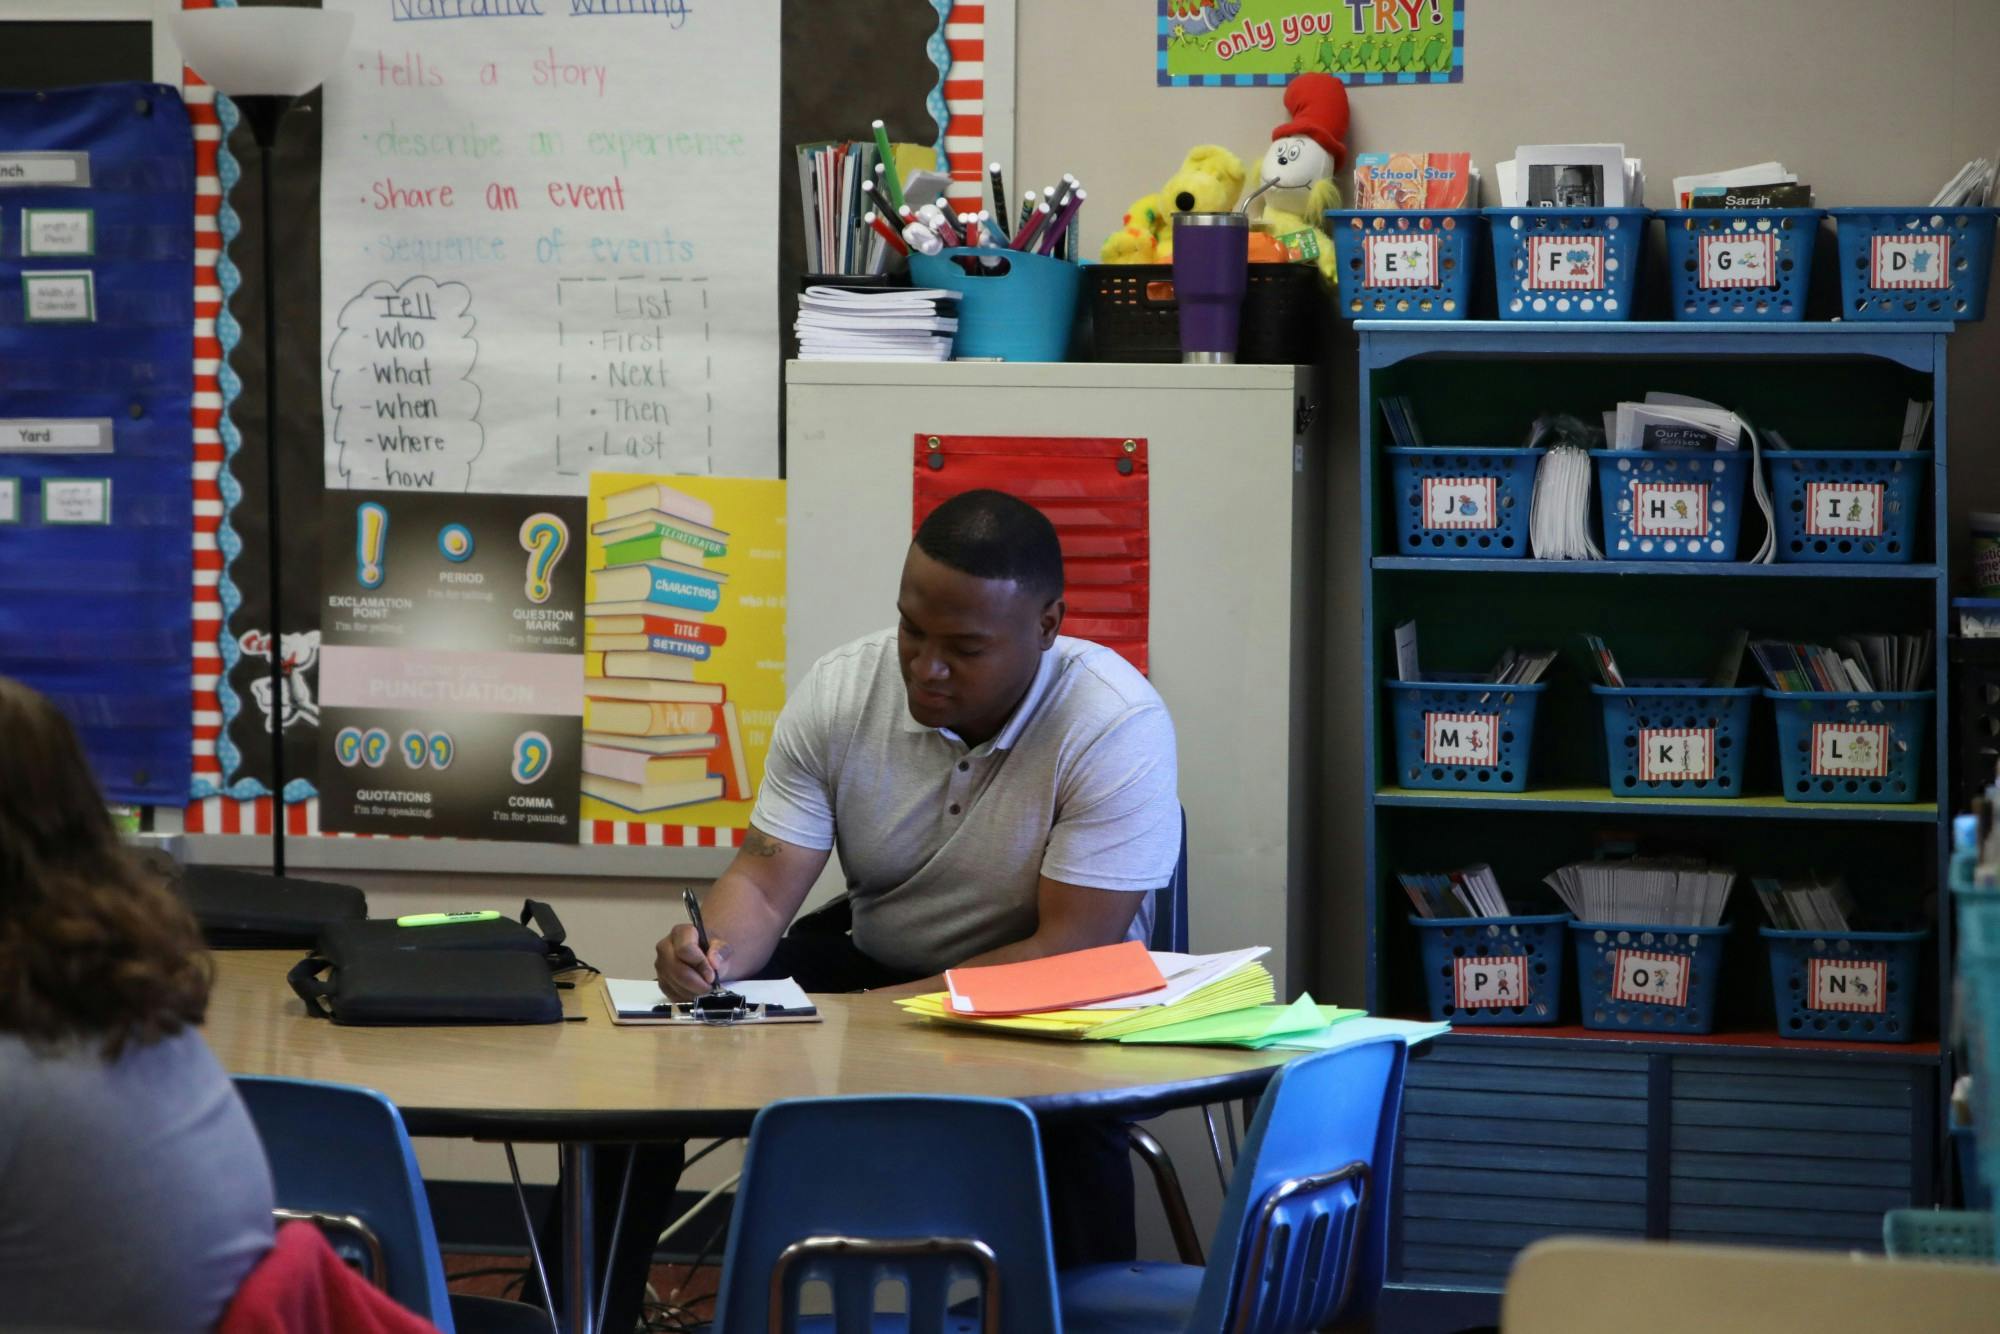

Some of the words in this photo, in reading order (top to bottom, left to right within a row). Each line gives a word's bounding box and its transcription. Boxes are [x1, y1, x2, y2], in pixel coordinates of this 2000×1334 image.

[1216, 18, 1274, 59] only
[1283, 13, 1332, 44] you
[1346, 0, 1443, 33] TRY!
[378, 51, 444, 87] tells
[479, 62, 499, 86] a
[532, 47, 607, 97] story
[375, 120, 503, 159] describe
[529, 130, 564, 157] an
[587, 129, 746, 168] experience
[1370, 167, 1419, 180] School
[1424, 168, 1456, 180] Star
[486, 181, 519, 211] an
[547, 175, 626, 211] event
[1725, 195, 1771, 206] Sarah
[536, 226, 563, 264] of
[590, 226, 695, 264] events
[1385, 253, 1398, 272] E
[1550, 252, 1562, 272] F
[1717, 250, 1732, 271] G
[1892, 251, 1907, 271] D
[613, 285, 673, 319] List
[602, 325, 664, 352] First
[372, 356, 432, 387] what
[609, 358, 671, 388] Next
[376, 391, 439, 420] when
[608, 397, 671, 426] Then
[18, 428, 51, 443] Yard
[377, 424, 445, 453] where
[1655, 429, 1679, 439] Our
[1683, 430, 1708, 440] Five
[603, 431, 665, 459] Last
[385, 457, 435, 488] how
[1444, 495, 1455, 515] J
[1650, 499, 1666, 519] H
[1828, 498, 1841, 518] I
[439, 572, 484, 584] PERIOD
[328, 596, 413, 609] EXCLAMATION
[353, 608, 388, 618] POINT
[513, 609, 574, 621] QUESTION
[526, 620, 560, 631] MARK
[673, 623, 700, 638] TITLE
[653, 638, 706, 655] SETTING
[369, 680, 536, 702] PUNCTUATION
[1439, 728, 1460, 748] M
[1659, 744, 1673, 764] K
[1831, 739, 1843, 759] L
[357, 789, 432, 803] QUOTATIONS
[508, 796, 553, 809] COMMA
[354, 804, 369, 815] I'm
[371, 805, 386, 815] for
[388, 807, 433, 819] speaking.
[493, 810, 508, 821] I'm
[511, 812, 525, 822] for
[527, 813, 567, 825] pausing.
[1474, 972, 1489, 991] P
[1632, 968, 1650, 988] O
[1829, 975, 1847, 994] N
